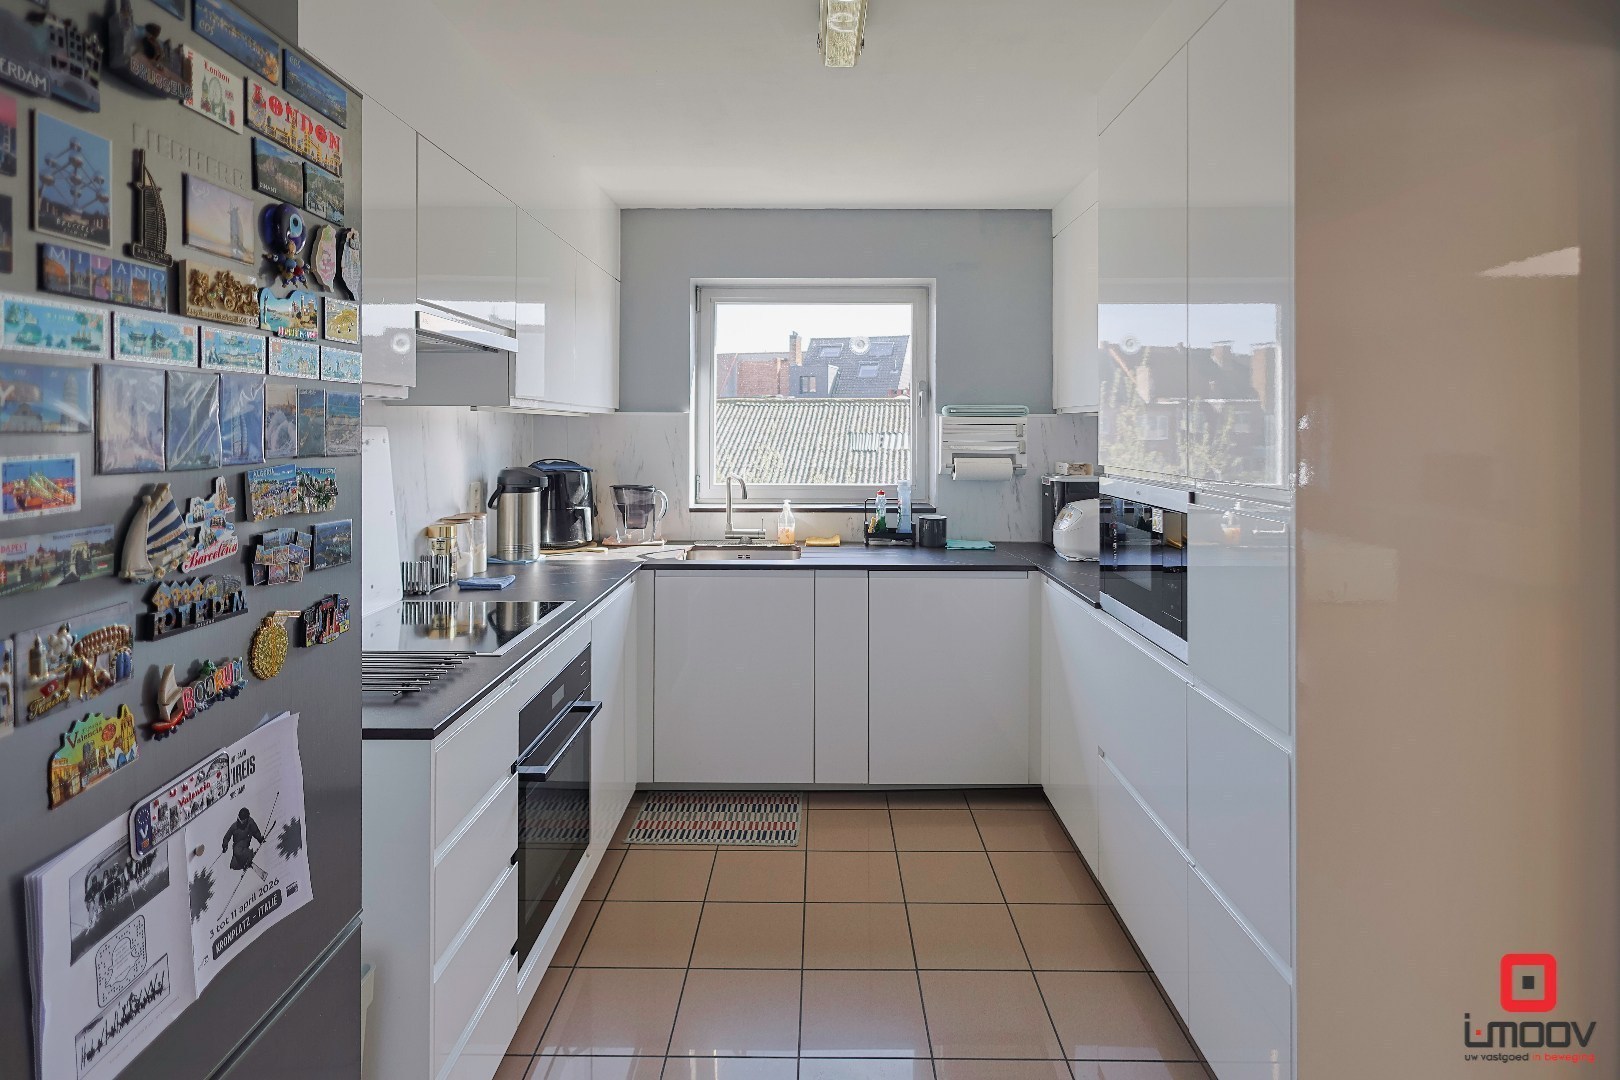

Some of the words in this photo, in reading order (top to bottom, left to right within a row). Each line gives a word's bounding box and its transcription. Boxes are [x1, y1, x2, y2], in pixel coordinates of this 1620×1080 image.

[203, 60, 230, 84] London
[252, 83, 341, 151] LONDON
[50, 246, 165, 283] MILANO
[184, 546, 238, 571] Barcelona
[182, 656, 243, 715] BODRUM
[66, 726, 103, 749] Valencia
[178, 781, 211, 807] Valencia
[209, 929, 215, 939] 3
[216, 918, 229, 933] tot
[230, 910, 237, 921] 11
[239, 891, 257, 915] april
[258, 878, 280, 897] 2026
[215, 916, 251, 954] KRONPLATZ
